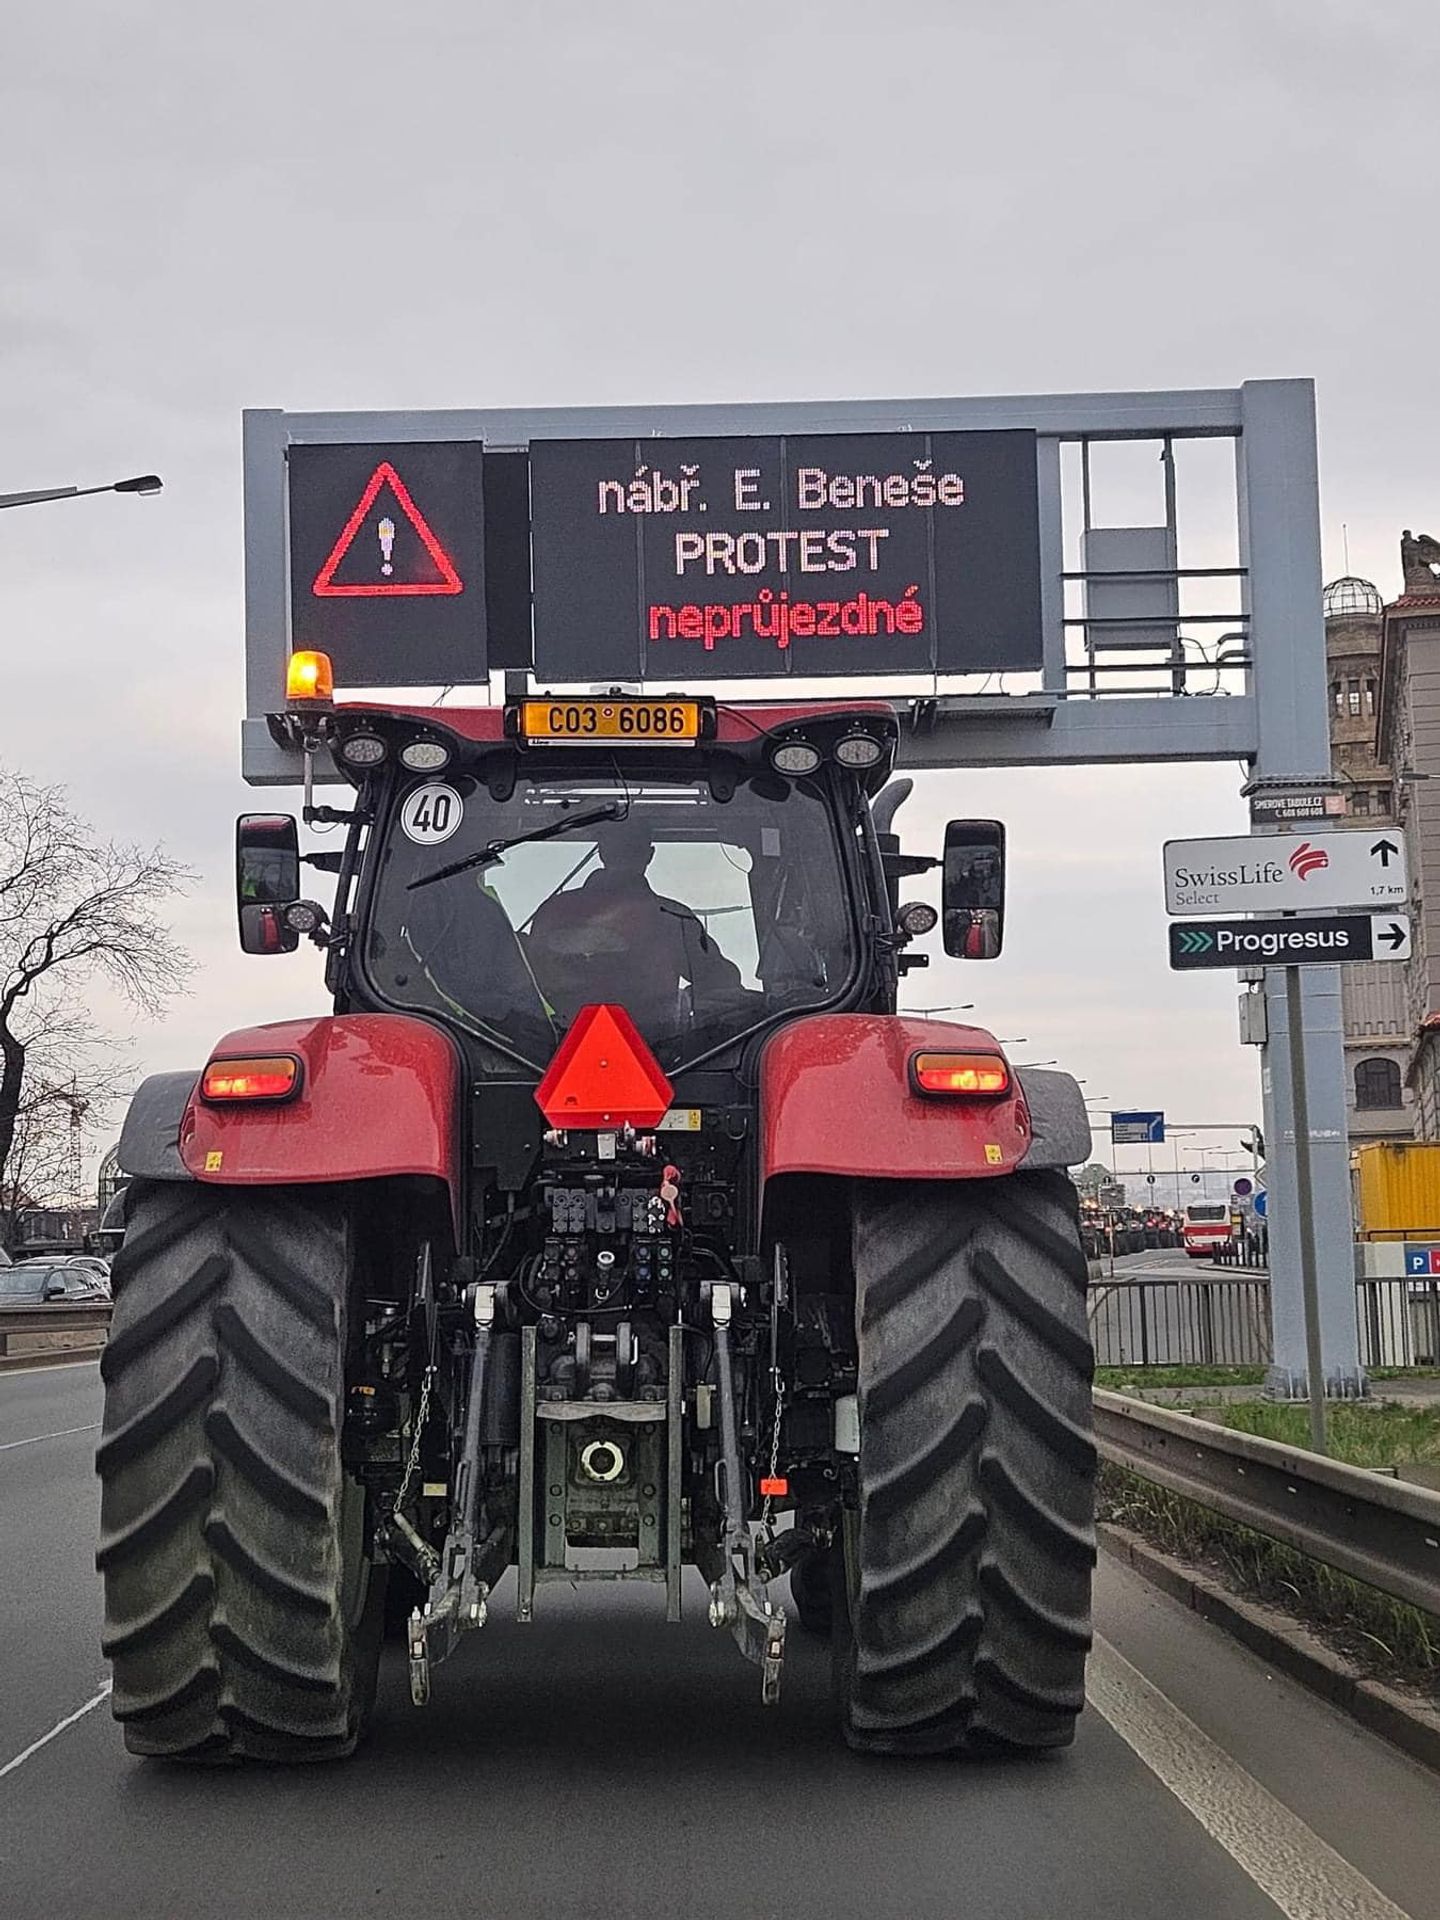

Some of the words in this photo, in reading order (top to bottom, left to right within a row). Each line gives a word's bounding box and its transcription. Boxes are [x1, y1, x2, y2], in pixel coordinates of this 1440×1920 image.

[599, 465, 707, 514] nábř.
[735, 468, 770, 510] E.
[798, 459, 965, 509] Beneše
[675, 529, 890, 575] PROTEST
[649, 584, 924, 650] neprůjezdné
[619, 707, 685, 733] 6086
[412, 794, 452, 832] 40
[1175, 890, 1220, 906] Select
[1370, 886, 1385, 896] 1,7
[1387, 885, 1404, 894] km
[1217, 930, 1350, 955] Progresus
[1412, 1256, 1424, 1270] P
